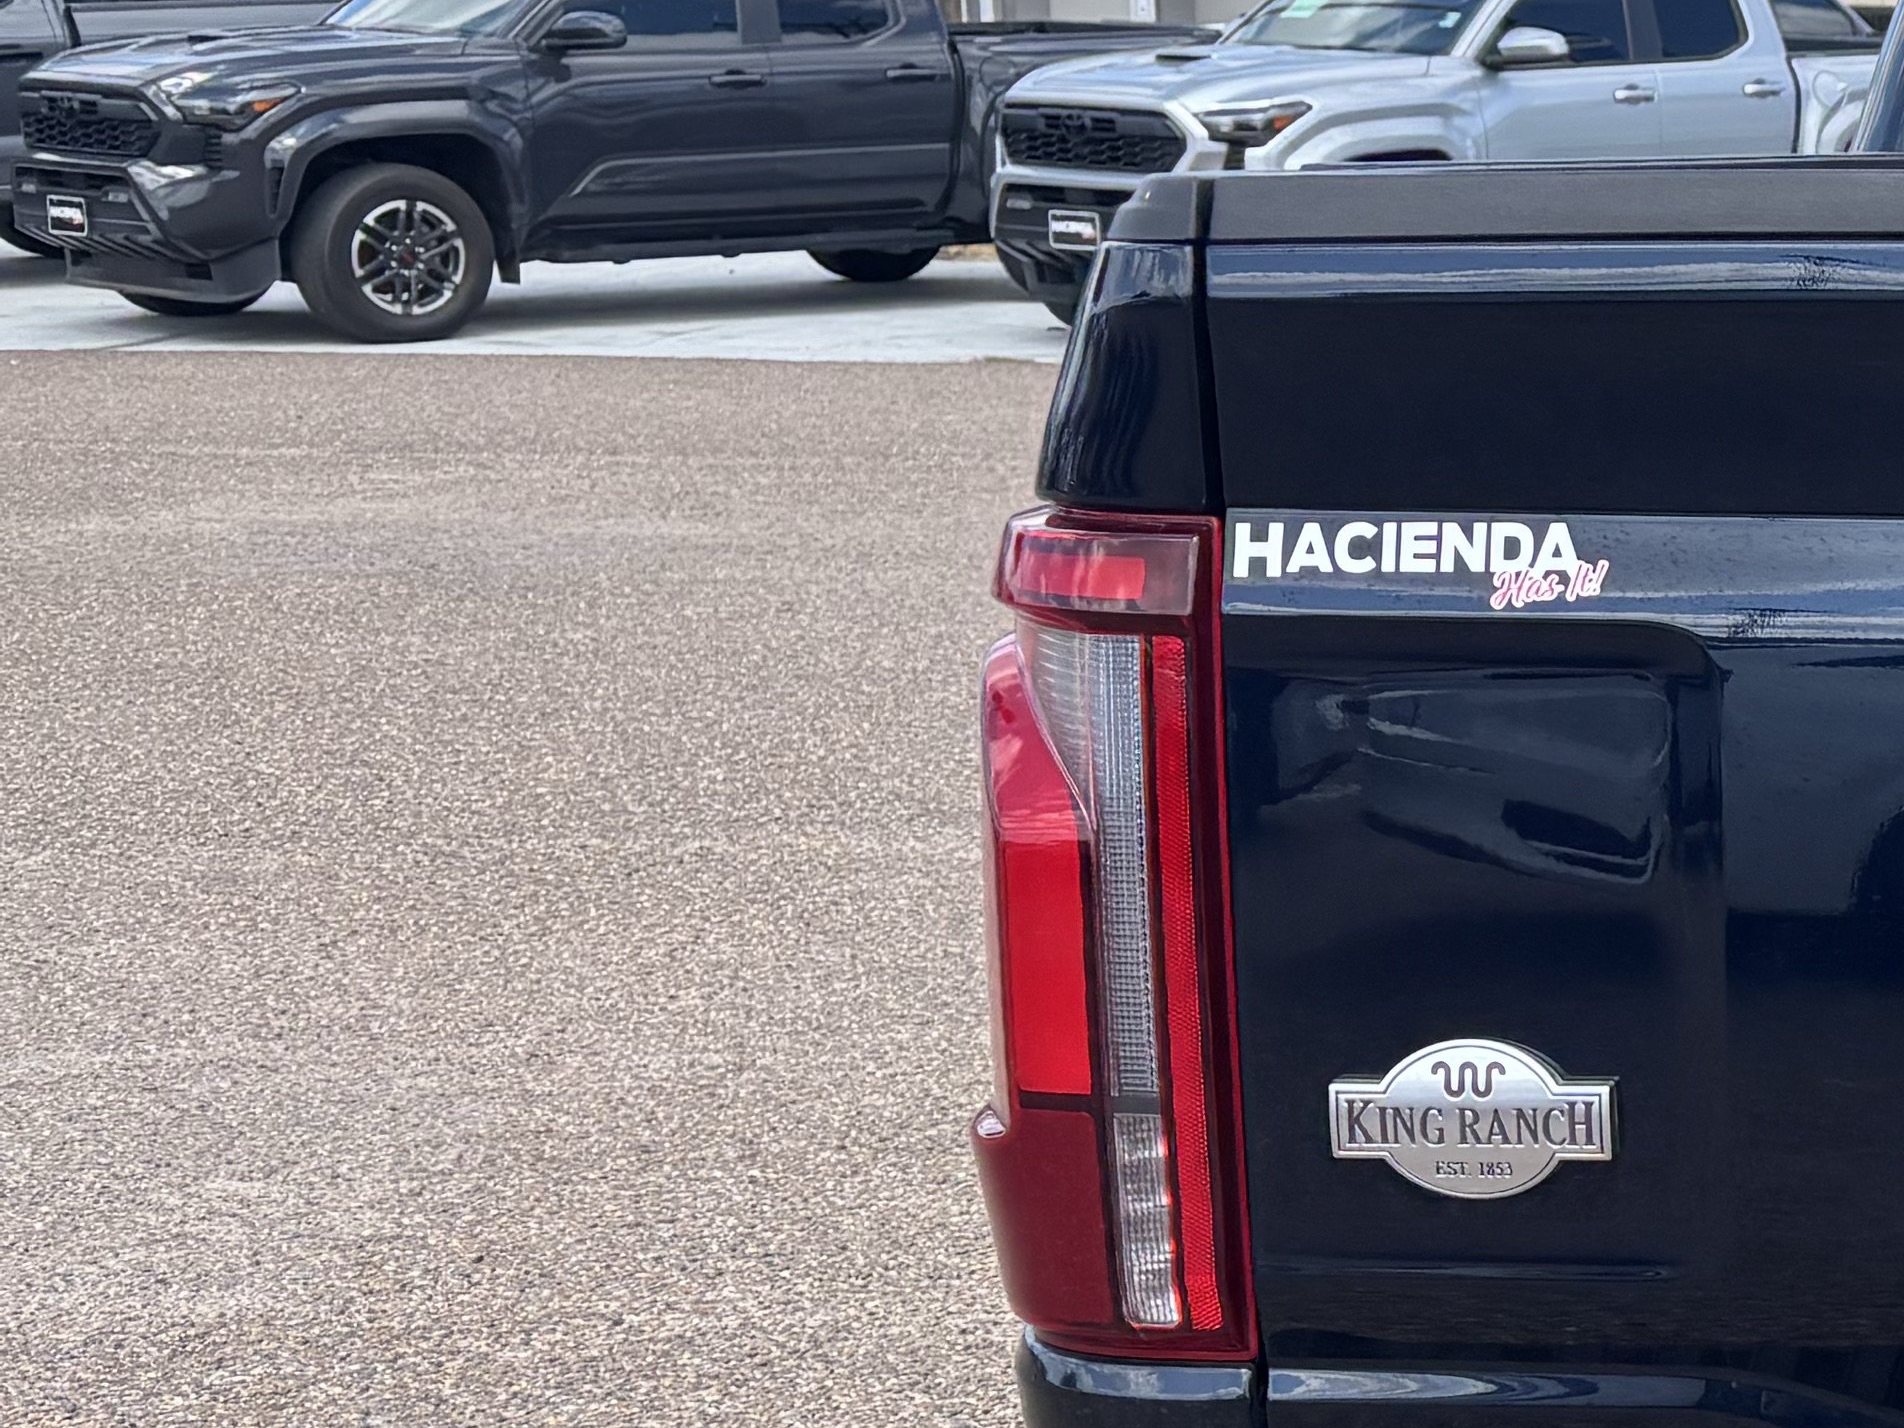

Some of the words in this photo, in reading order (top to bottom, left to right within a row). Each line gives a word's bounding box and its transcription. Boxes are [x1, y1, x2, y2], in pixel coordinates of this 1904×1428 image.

[1232, 521, 1580, 578] HACIENDA
[1490, 567, 1565, 610] Has
[1343, 1099, 1447, 1147] KING
[1457, 1100, 1598, 1148] RANCH
[1434, 1160, 1471, 1177] EST.
